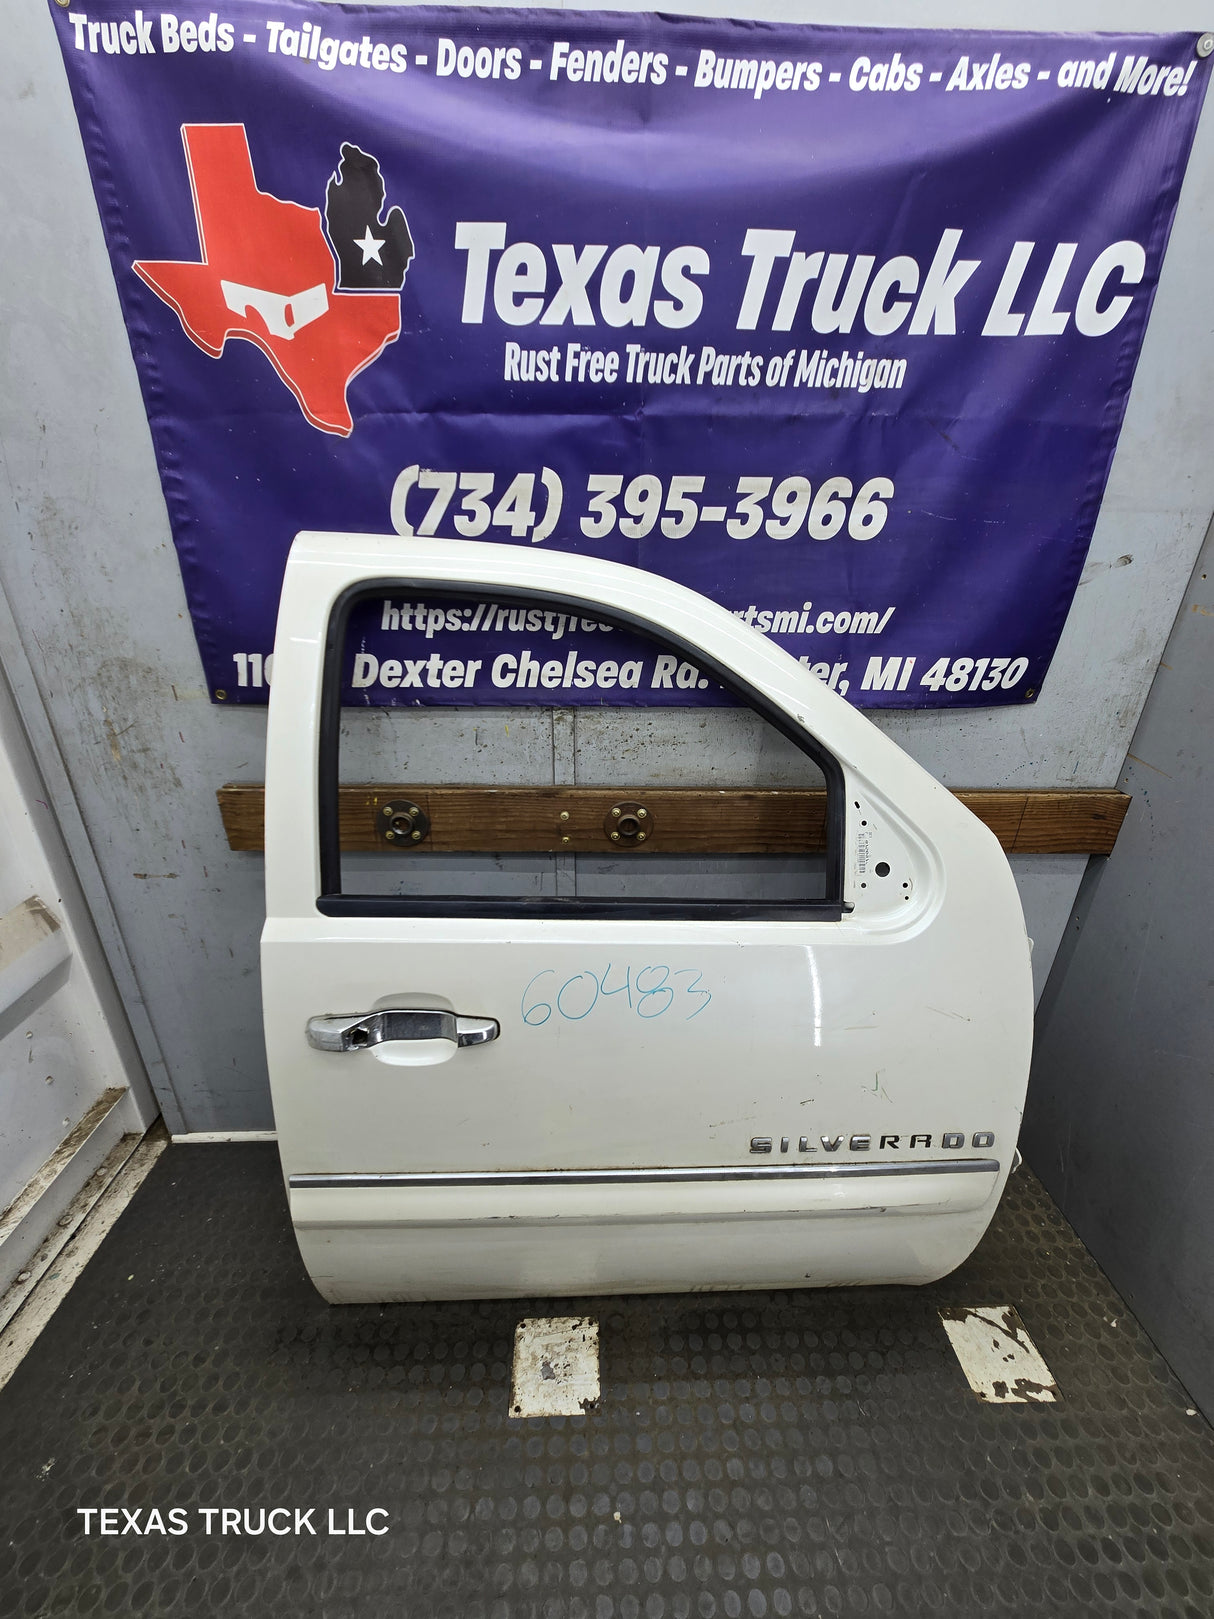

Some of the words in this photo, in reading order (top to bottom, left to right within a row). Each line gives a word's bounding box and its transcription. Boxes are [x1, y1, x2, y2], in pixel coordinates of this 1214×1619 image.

[69, 10, 156, 54] Truck
[161, 12, 235, 53] Beds
[266, 21, 407, 73] Tailgates
[435, 38, 522, 80] Doors
[549, 40, 668, 84] Fenders
[694, 49, 822, 99] Bumpers
[848, 53, 921, 92] Cabs
[945, 53, 1030, 92] Axles
[1056, 52, 1116, 92] and
[1113, 55, 1198, 97] More!
[454, 221, 711, 329] Texas
[735, 228, 982, 337] Truck
[980, 240, 1147, 338] LLC
[504, 341, 560, 383] Rust
[565, 342, 620, 384] Free
[625, 343, 694, 385] Truck
[696, 346, 764, 387] Parts
[766, 349, 797, 388] of
[797, 349, 908, 393] Michigan
[389, 464, 563, 543] (734)
[579, 474, 895, 541] 395-3966
[351, 653, 482, 688] Dexter
[490, 650, 643, 689] Chelsea
[860, 656, 915, 691] MI
[919, 657, 1029, 692] 48130
[521, 963, 712, 1026] 60483
[749, 1131, 996, 1154] SILVERADO
